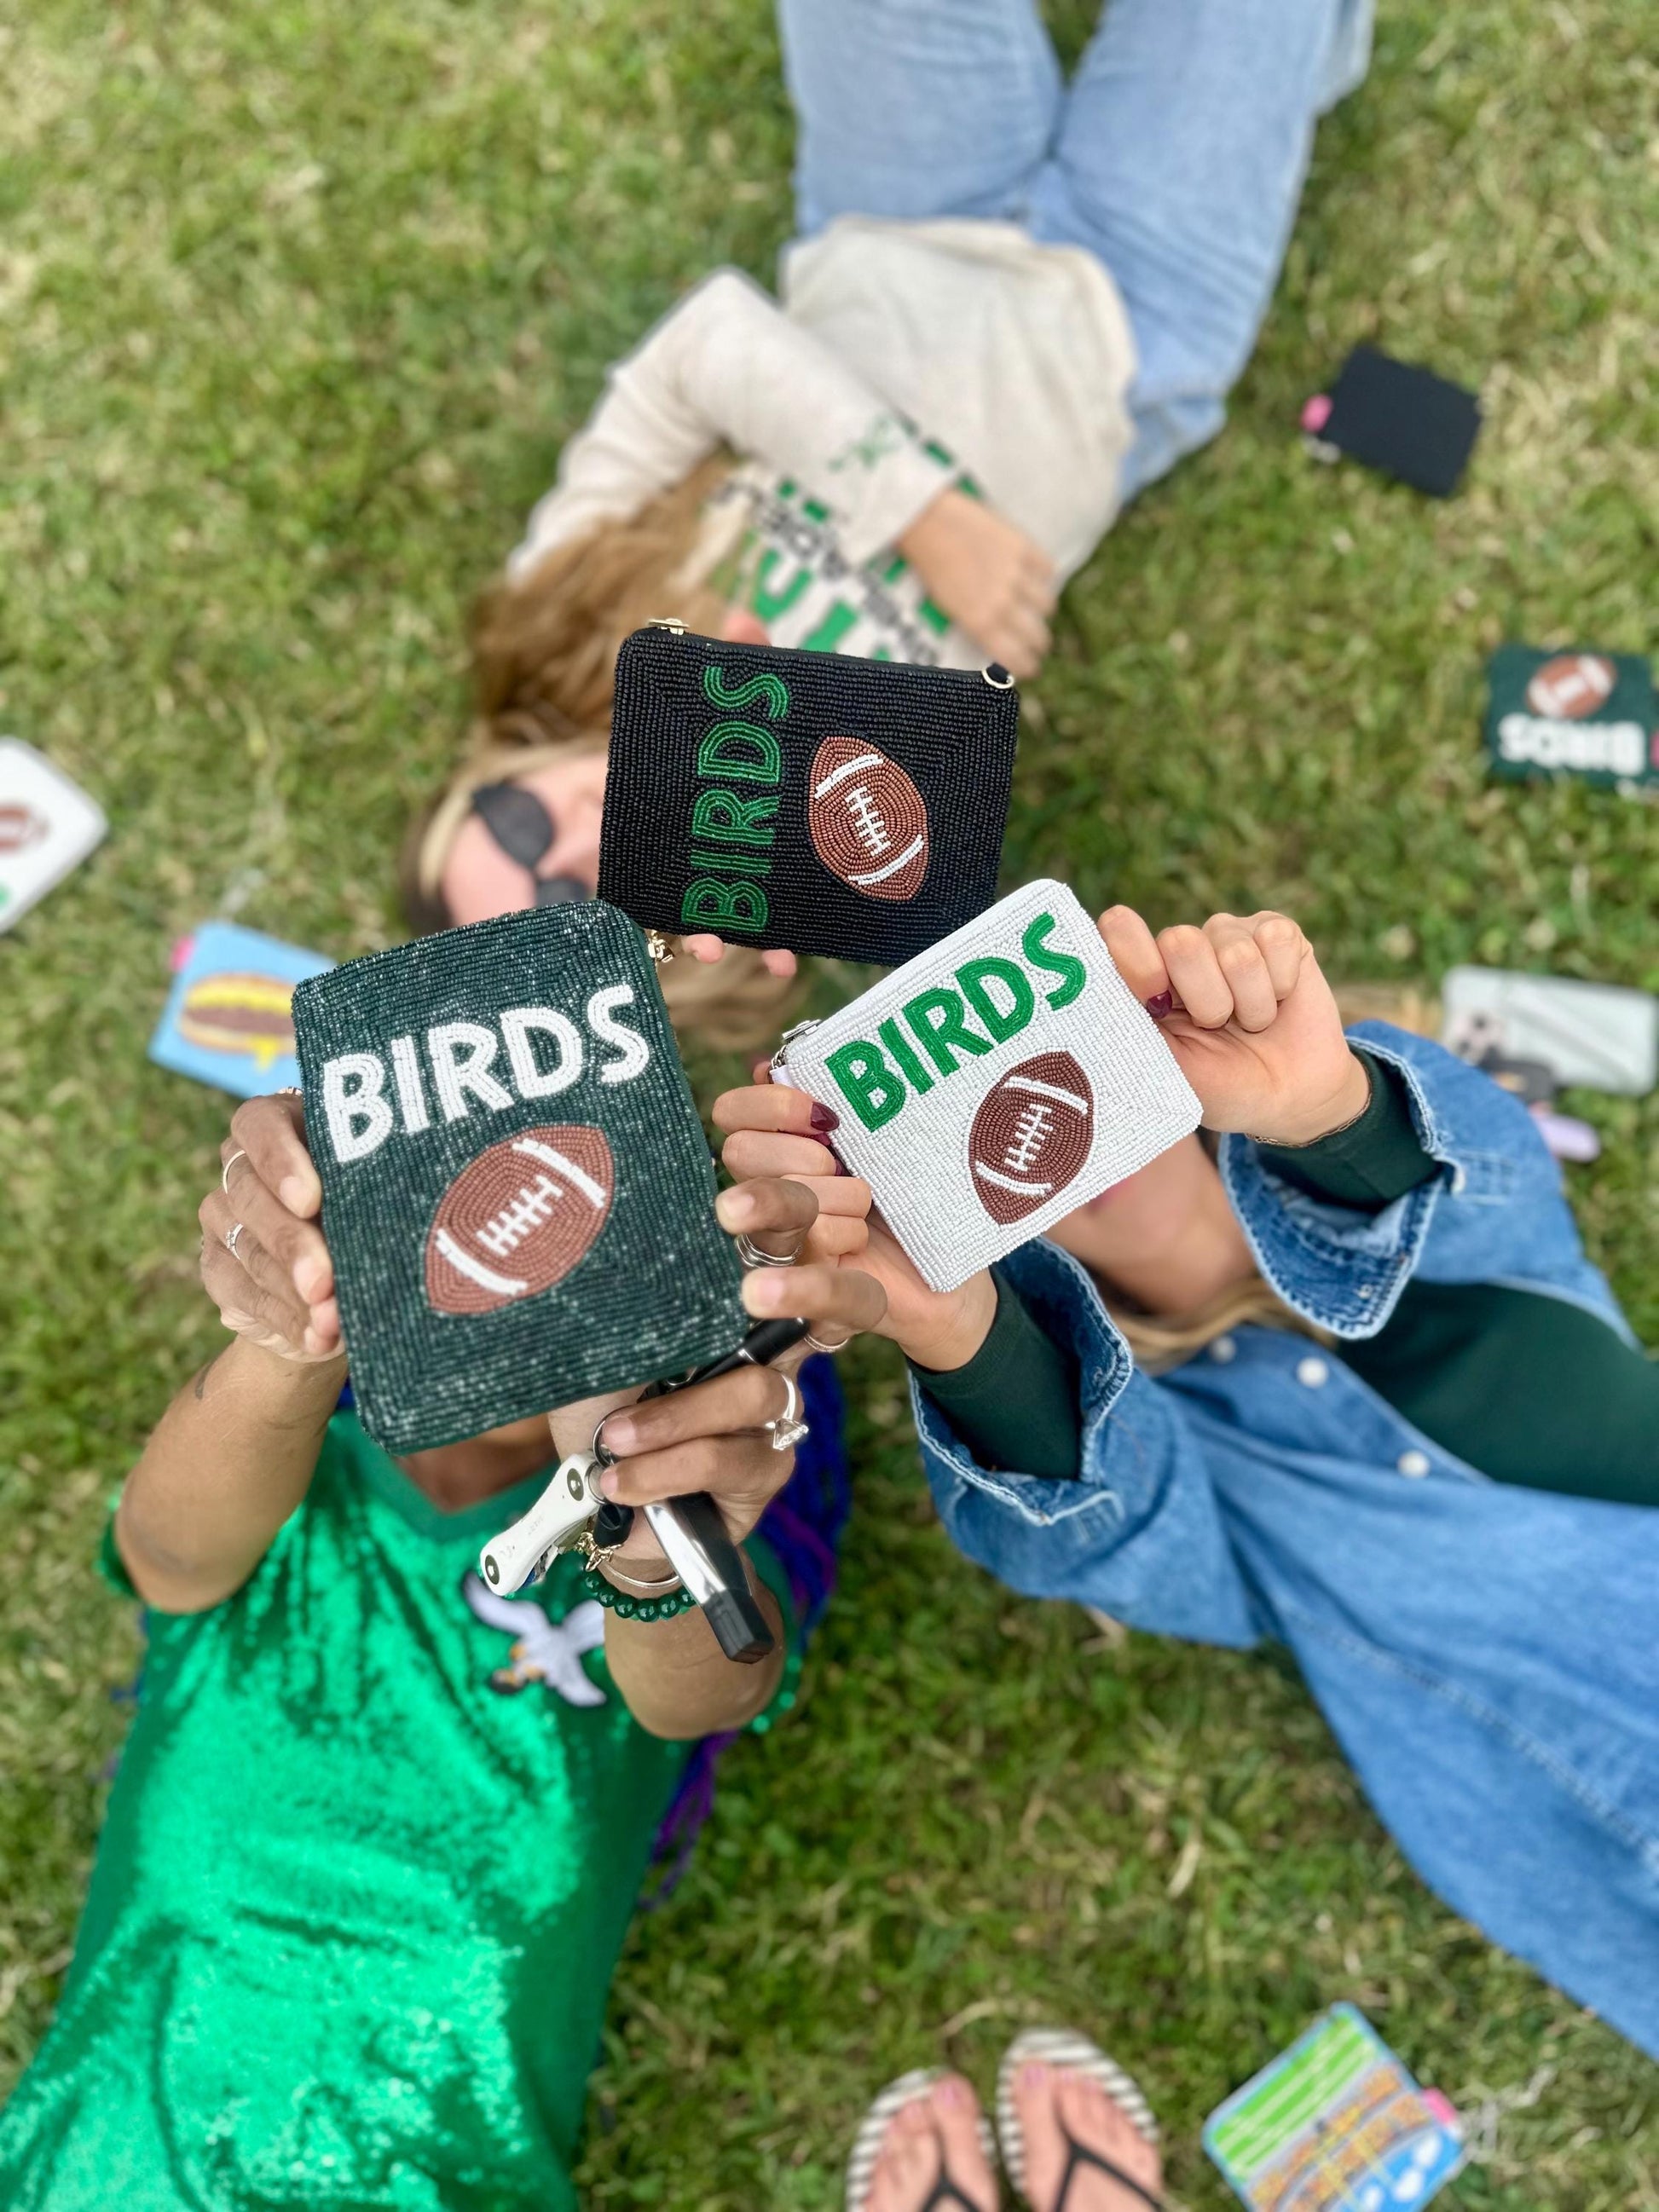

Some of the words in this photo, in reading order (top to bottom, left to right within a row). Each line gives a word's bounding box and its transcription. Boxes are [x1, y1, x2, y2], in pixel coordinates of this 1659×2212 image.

[681, 665, 790, 933] BIRDS
[323, 984, 650, 1163] BIRDS
[824, 911, 1087, 1133] BIRDS
